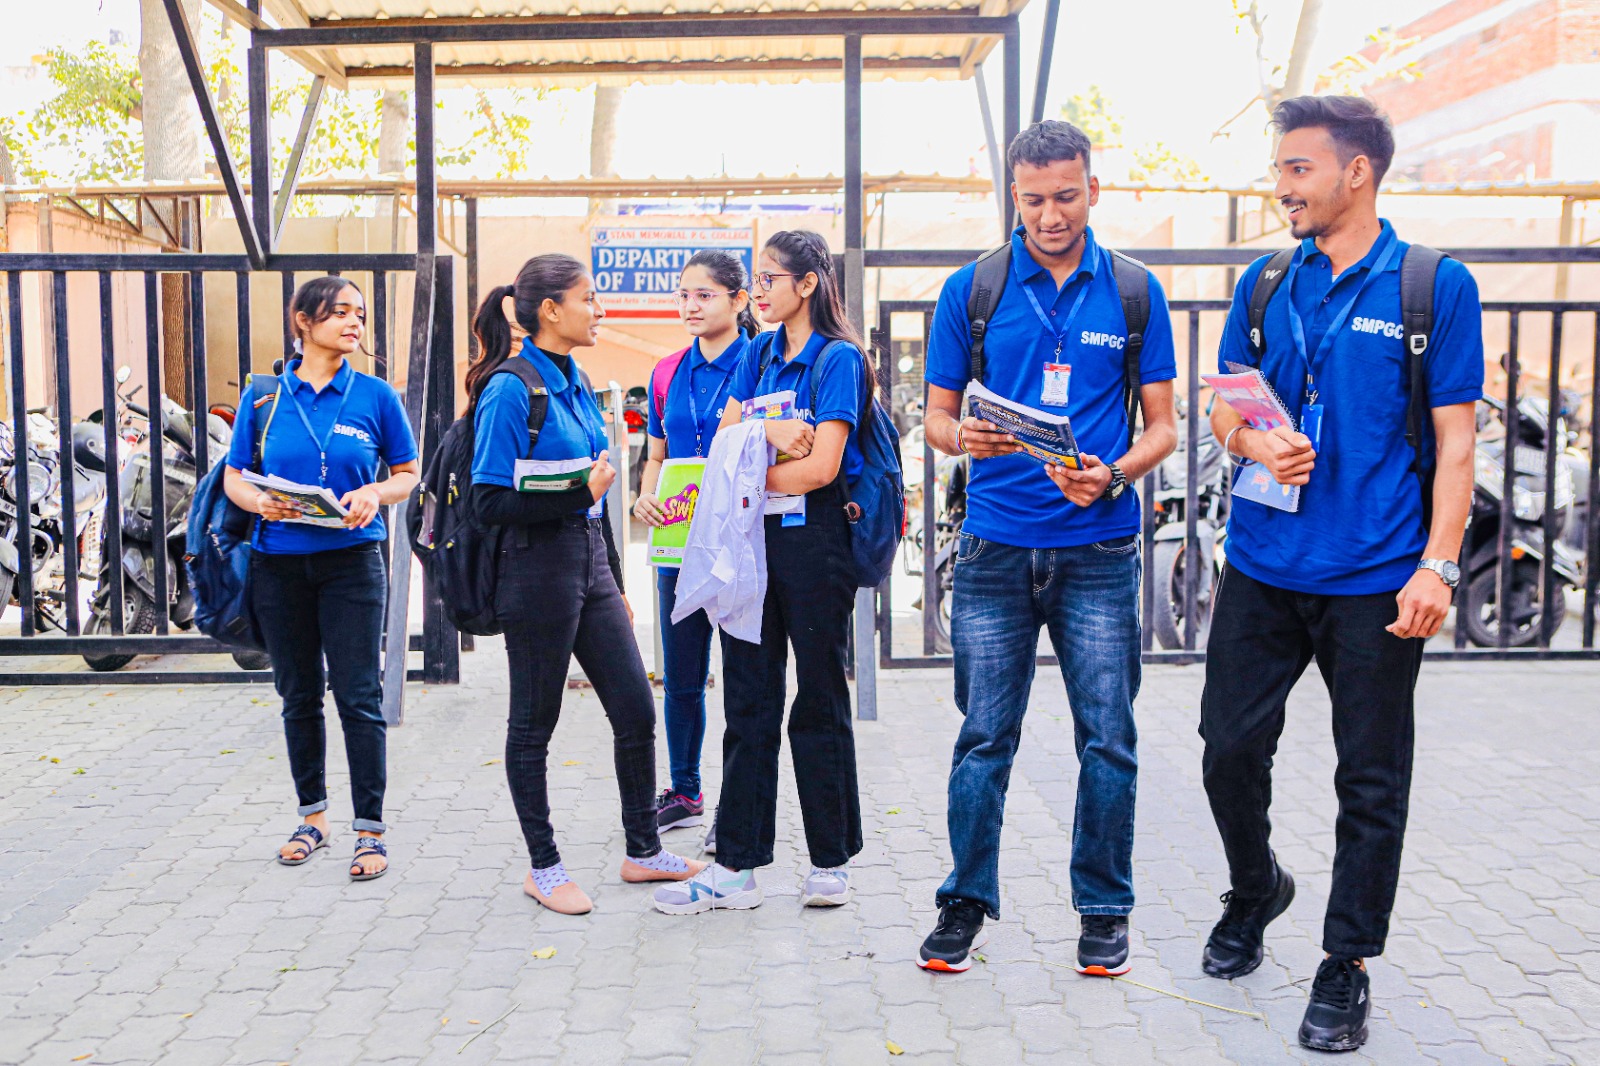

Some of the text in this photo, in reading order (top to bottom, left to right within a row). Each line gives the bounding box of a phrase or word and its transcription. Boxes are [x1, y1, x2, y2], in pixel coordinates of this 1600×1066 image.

[610, 230, 636, 240] STANI
[640, 230, 687, 240] MEMORIAL
[711, 230, 750, 240] COLLEGE
[595, 271, 682, 292] OF FINE
[599, 296, 622, 304] Visual
[1351, 316, 1404, 340] SMPGC
[1080, 330, 1126, 350] SMPGC
[333, 423, 371, 443] SMPGC
